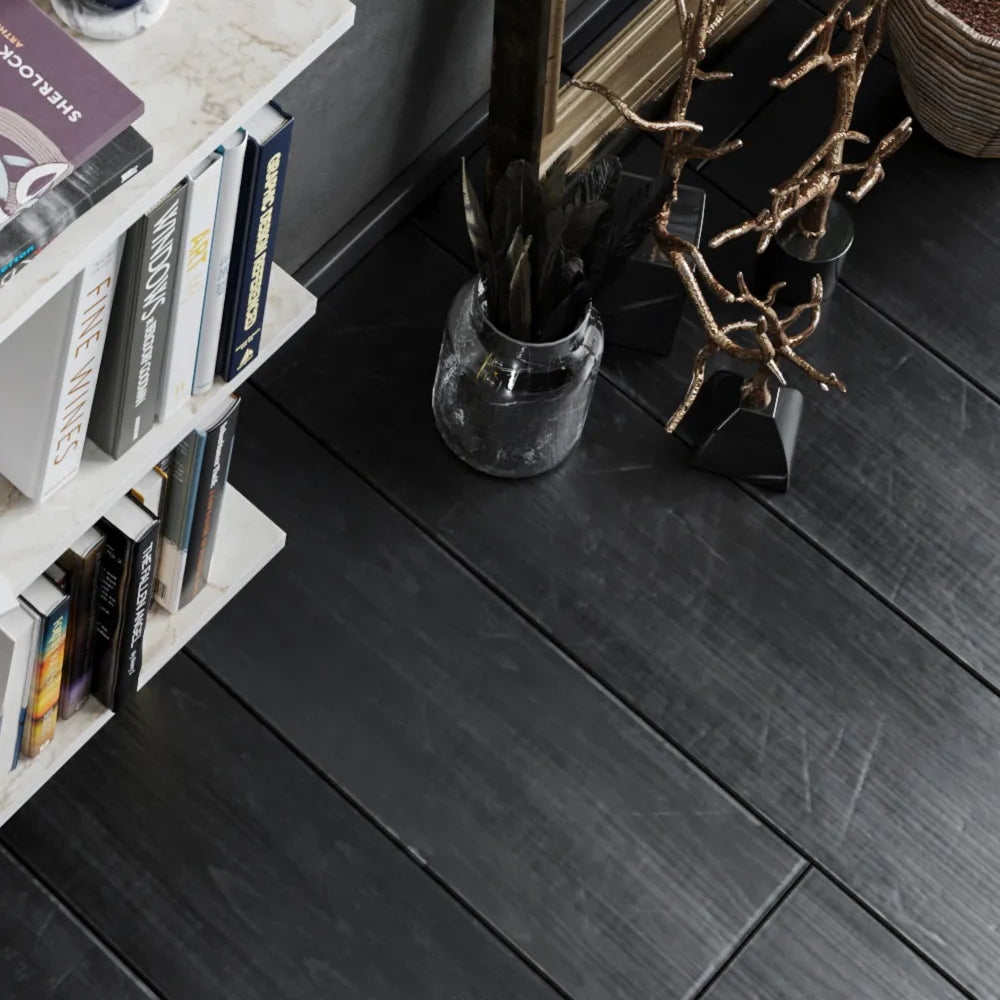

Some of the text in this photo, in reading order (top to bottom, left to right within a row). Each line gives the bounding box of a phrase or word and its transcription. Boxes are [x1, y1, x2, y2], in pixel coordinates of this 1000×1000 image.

[139, 198, 180, 322] WINDOWS
[186, 226, 211, 274] ART
[74, 275, 112, 359] FINE
[53, 355, 96, 467] WINES
[141, 541, 154, 567] THE
[136, 564, 152, 611] FALLEN
[131, 608, 146, 649] ANGEL
